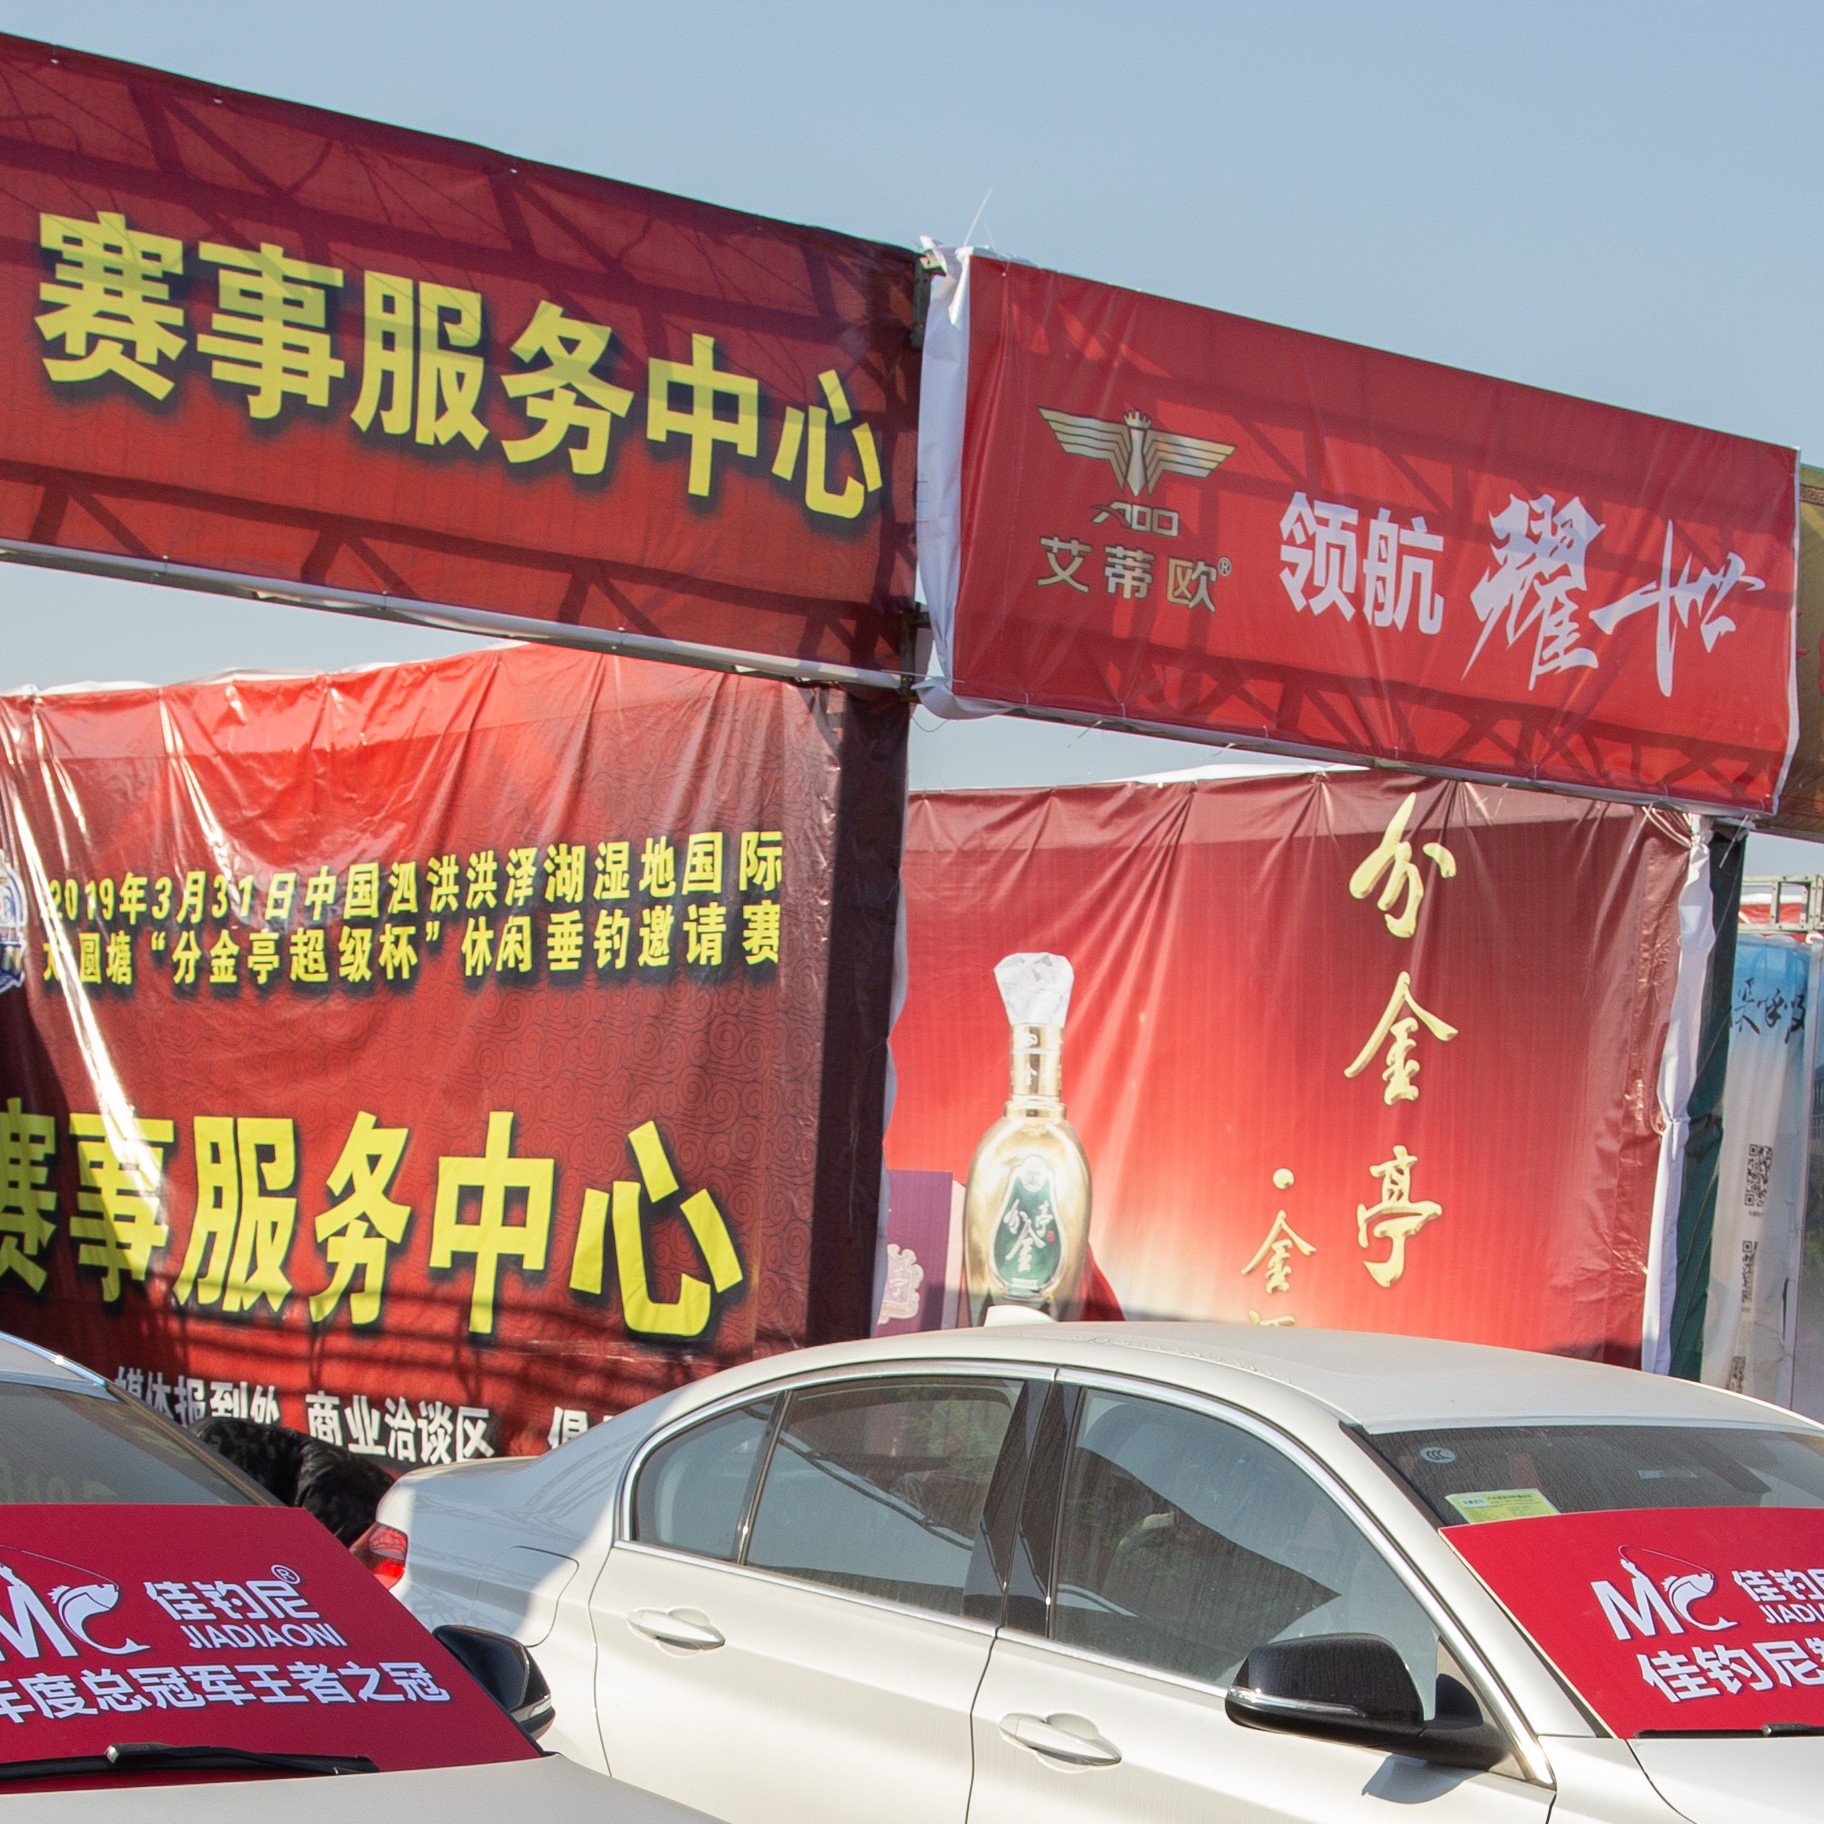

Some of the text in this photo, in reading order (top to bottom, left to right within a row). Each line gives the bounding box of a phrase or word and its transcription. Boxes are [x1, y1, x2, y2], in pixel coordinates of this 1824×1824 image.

[36, 210, 882, 519] 赛事服务中心
[1344, 792, 1460, 1289] 分金亭
[305, 1390, 496, 1465] 商业洽谈区
[180, 1622, 349, 1650] JIADIAONI
